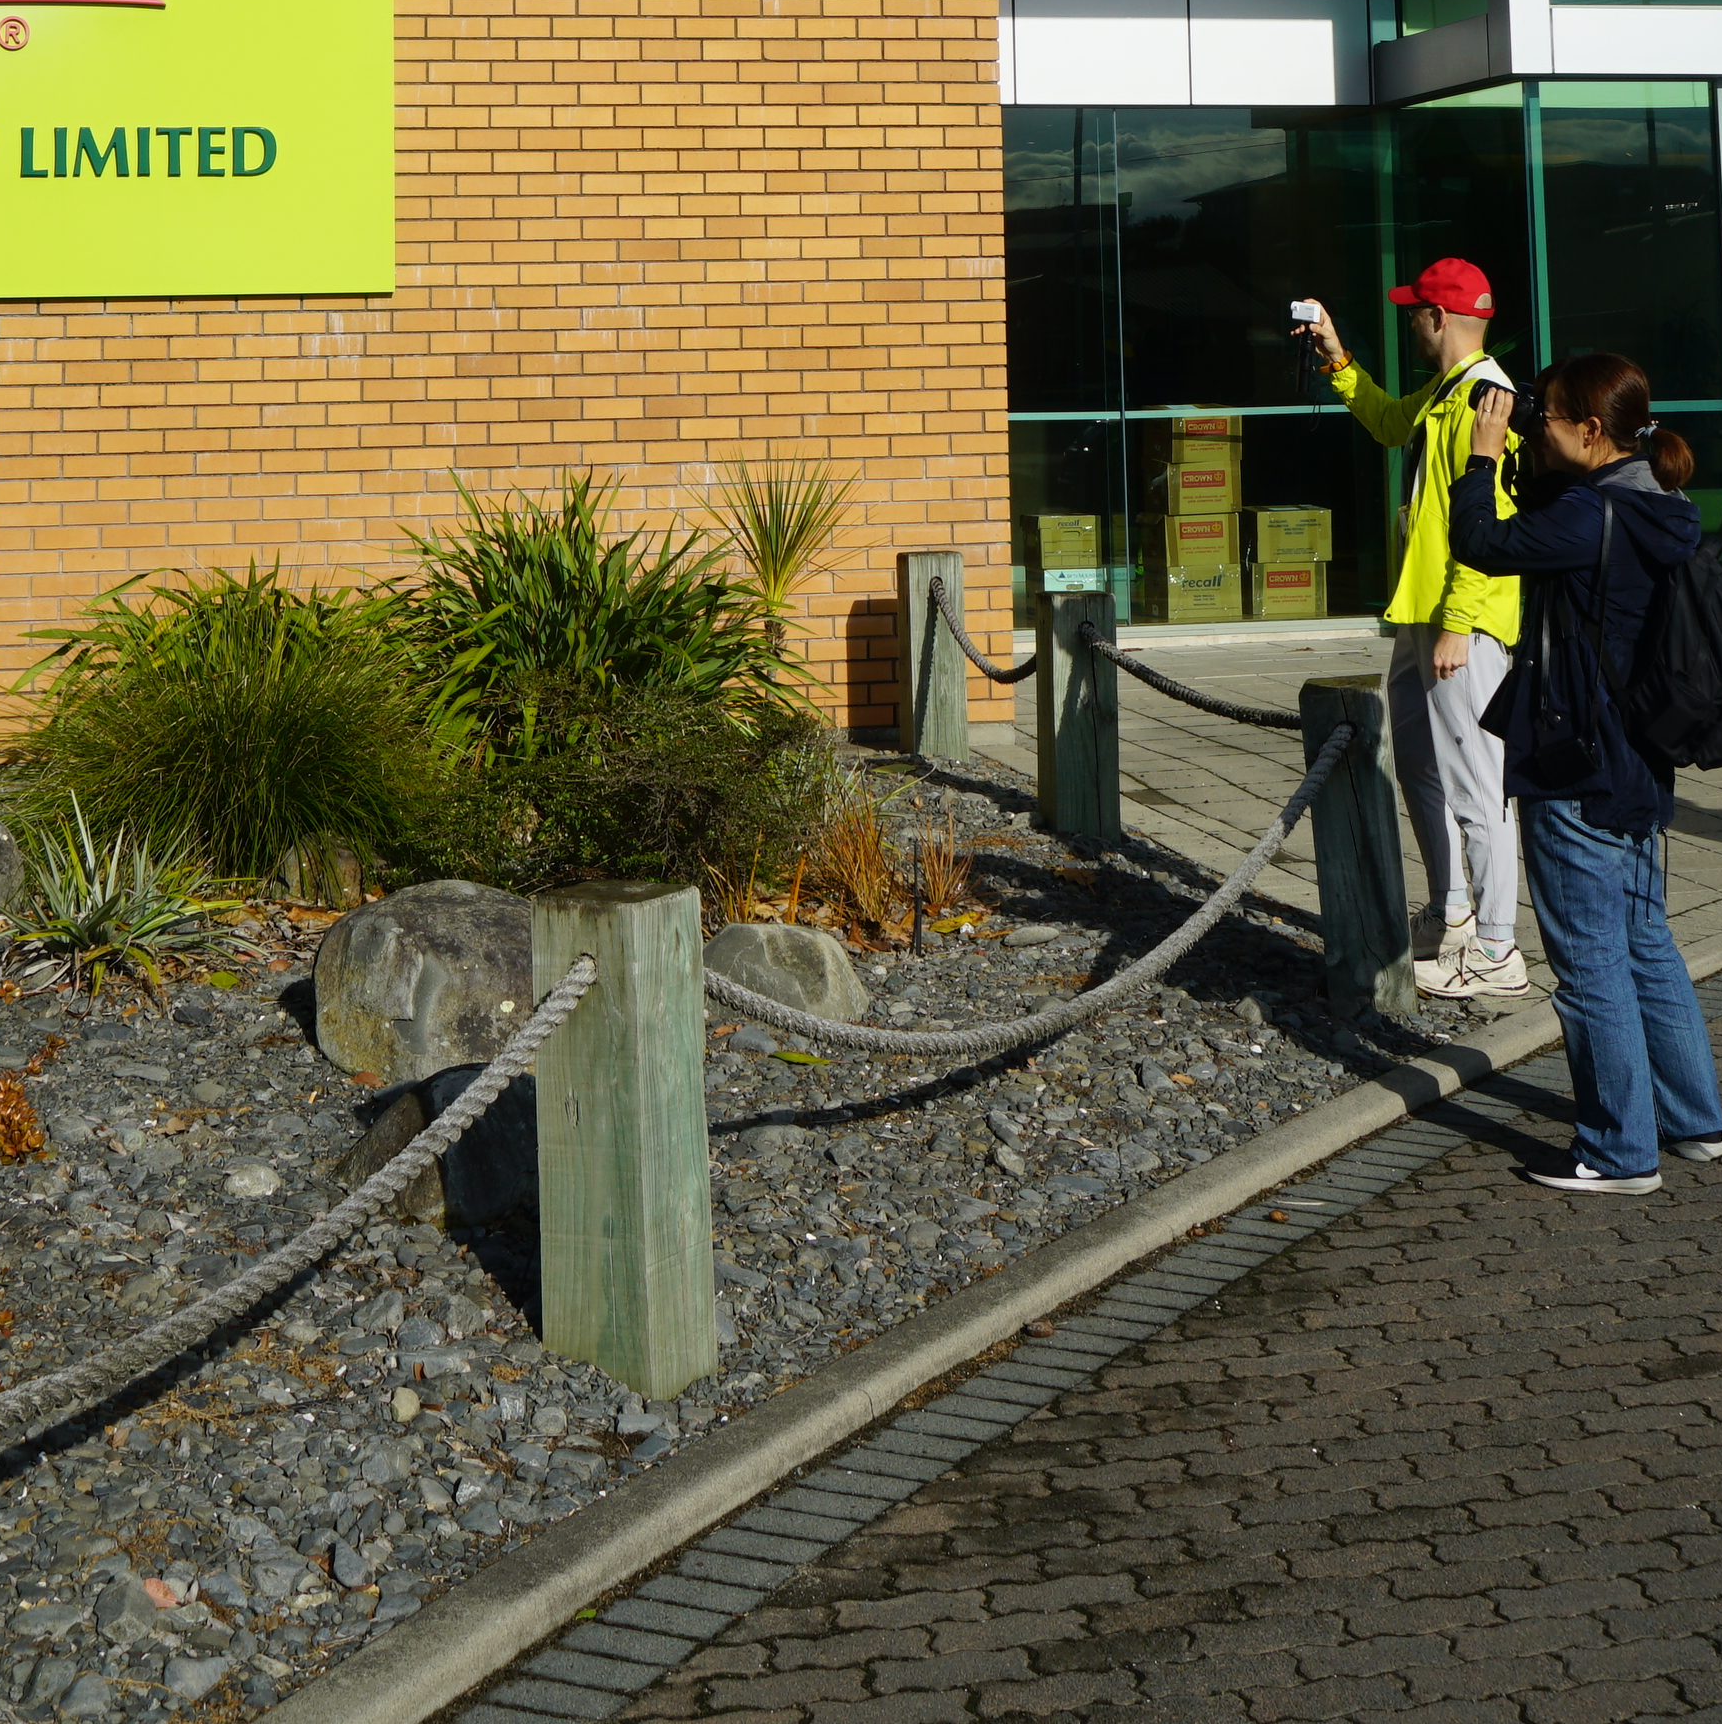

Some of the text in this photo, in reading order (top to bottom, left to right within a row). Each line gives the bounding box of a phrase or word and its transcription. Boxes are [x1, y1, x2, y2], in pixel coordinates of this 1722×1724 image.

[20, 126, 277, 180] LIMITED
[1187, 423, 1216, 431] CROWN
[1183, 474, 1213, 483] CROWN
[1057, 519, 1080, 527] recall
[1181, 525, 1211, 534] CROWN
[1181, 574, 1223, 588] recall
[1268, 574, 1299, 583] CROWN
